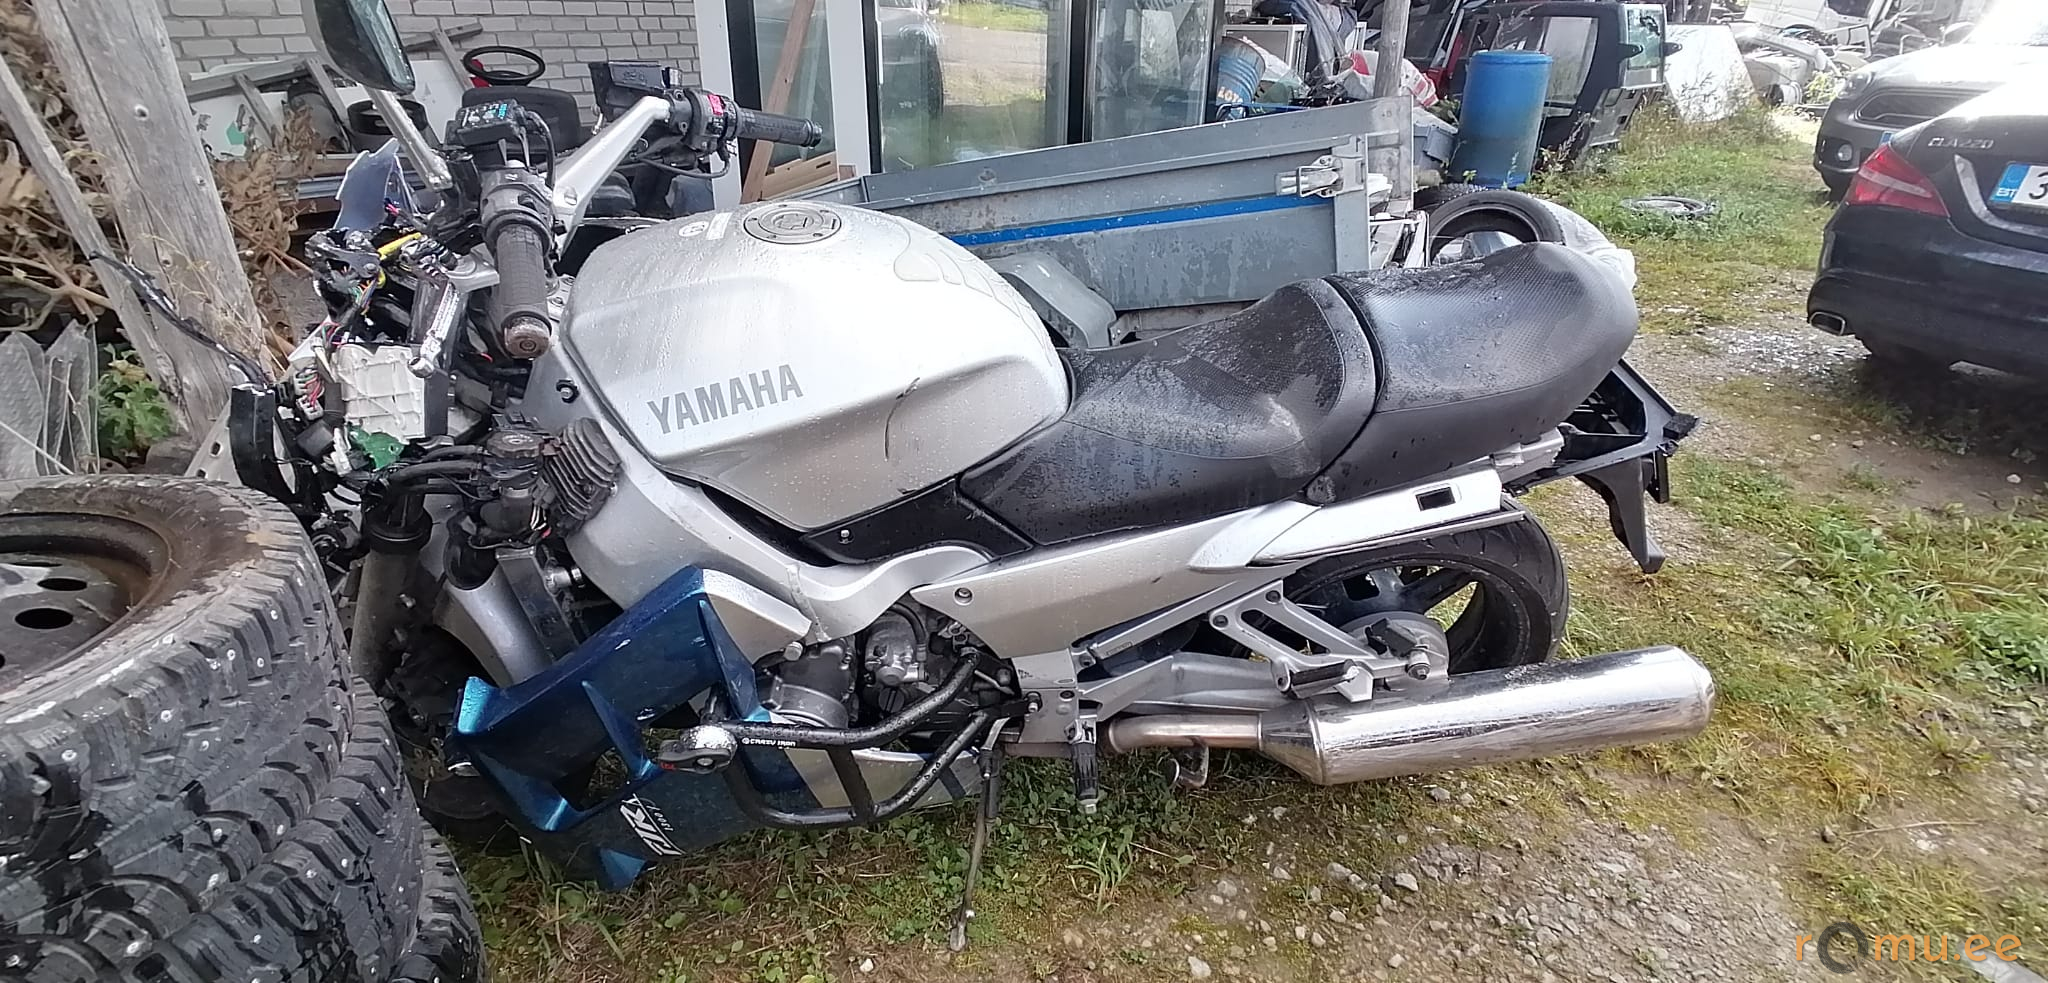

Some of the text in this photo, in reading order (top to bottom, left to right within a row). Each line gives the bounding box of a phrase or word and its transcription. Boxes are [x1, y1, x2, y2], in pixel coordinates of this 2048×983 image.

[647, 364, 803, 434] YAMAHA
[750, 738, 797, 748] CRAZY IRON
